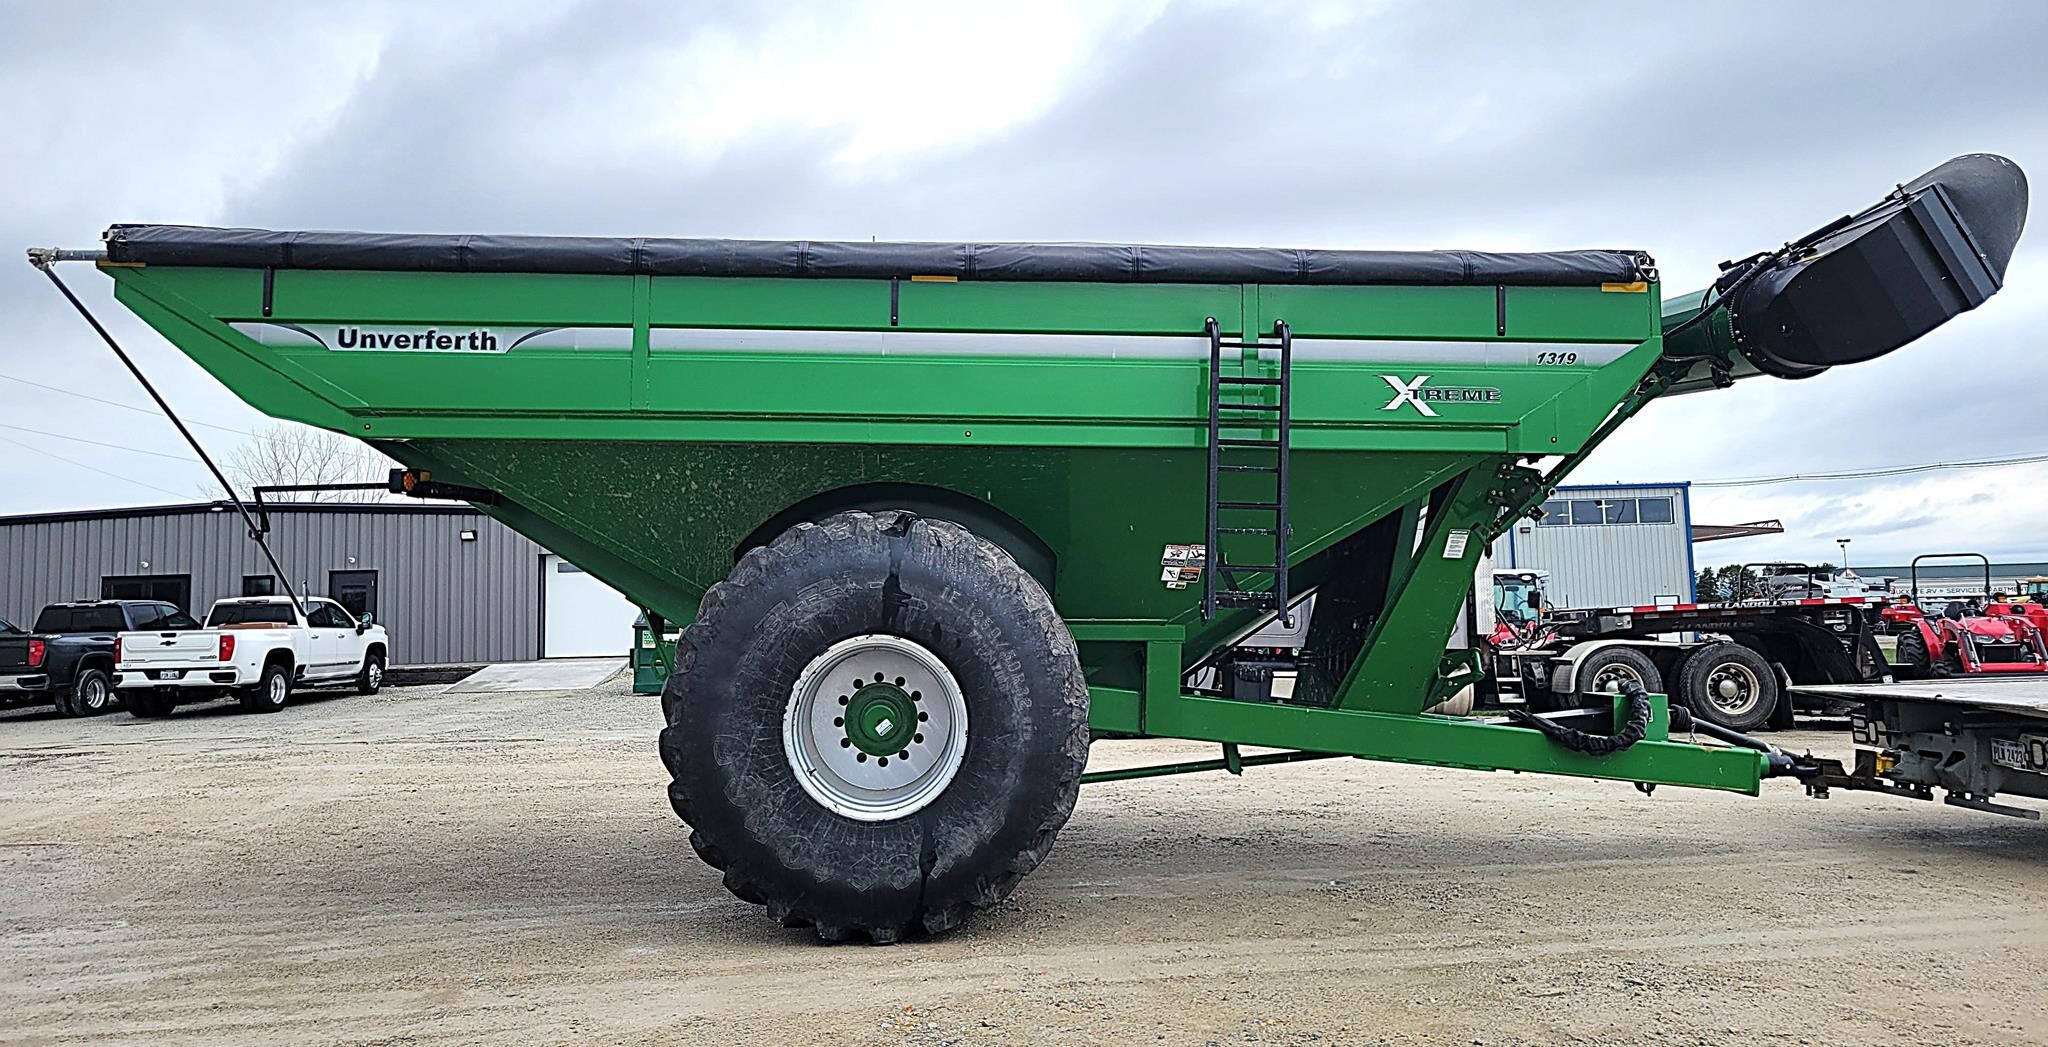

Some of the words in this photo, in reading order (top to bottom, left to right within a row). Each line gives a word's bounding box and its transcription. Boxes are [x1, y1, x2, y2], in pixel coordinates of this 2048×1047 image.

[338, 328, 498, 351] Unverferth
[1536, 352, 1577, 365] 1319
[1978, 586, 2027, 594] DPARTMT
[1724, 600, 1781, 610] LANDOLL
